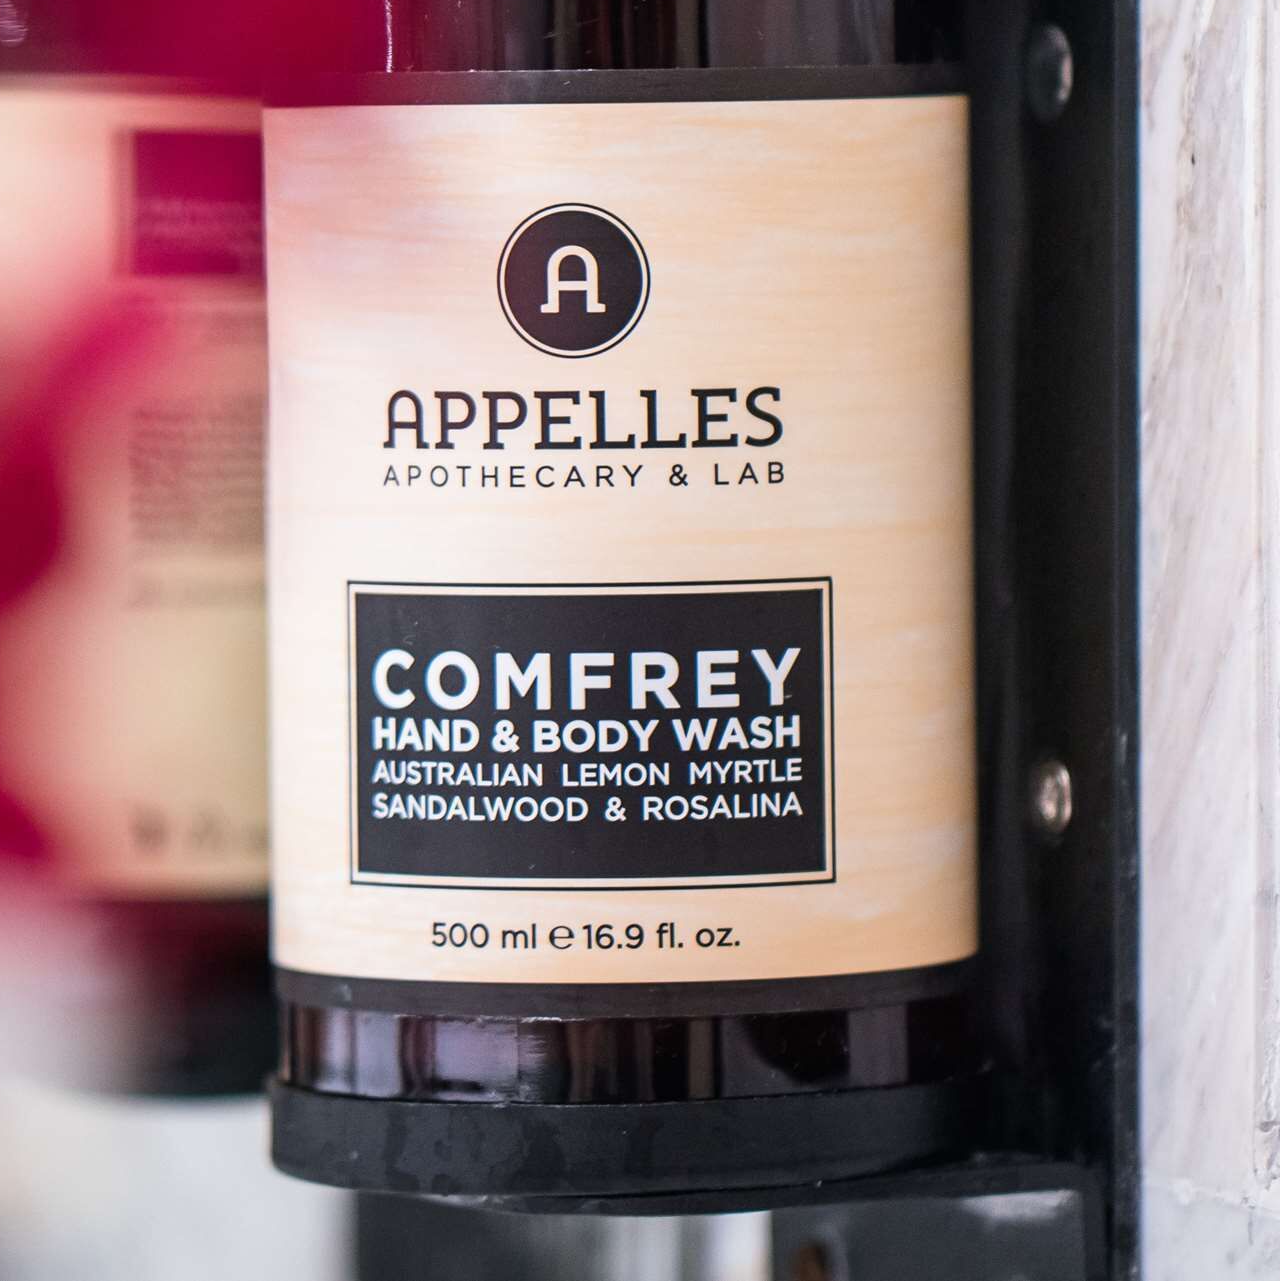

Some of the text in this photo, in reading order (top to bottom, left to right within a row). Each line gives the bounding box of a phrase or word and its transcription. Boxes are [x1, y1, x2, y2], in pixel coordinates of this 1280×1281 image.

[540, 245, 606, 314] A
[383, 386, 783, 450] APPELLES
[383, 461, 785, 488] APOTHECARY & LAB
[372, 647, 801, 711] COMFREY
[373, 714, 801, 753] HAND & BODY WASH
[372, 757, 803, 787] AUSTRALIAN LEMON MYRTLE
[372, 791, 803, 822] SANDALWOOD & ROSALINA
[431, 922, 490, 949] 500
[501, 923, 537, 949] ml
[656, 922, 684, 949] fl.
[695, 927, 740, 948] oz.
